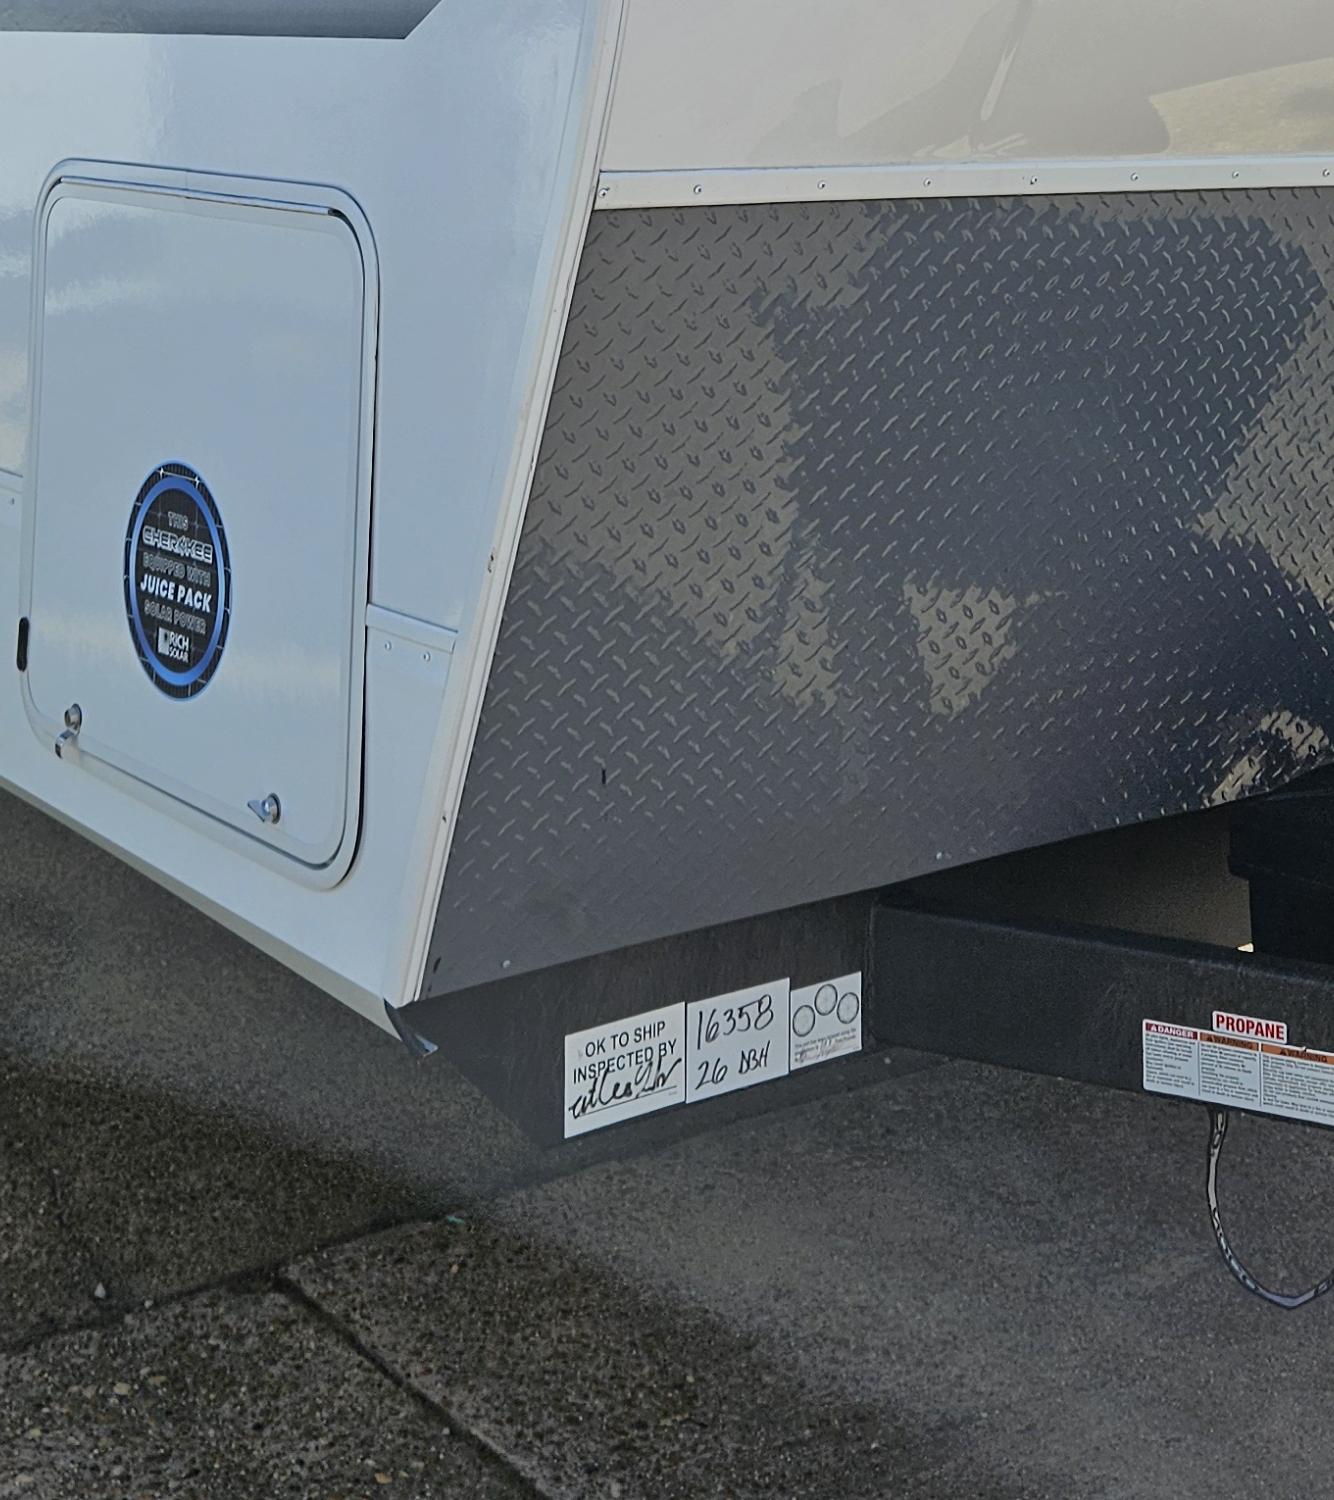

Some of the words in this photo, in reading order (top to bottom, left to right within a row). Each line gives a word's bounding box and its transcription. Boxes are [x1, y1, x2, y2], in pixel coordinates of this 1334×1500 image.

[167, 511, 189, 531] THIS
[142, 551, 186, 579] EQUIPPED
[186, 563, 211, 588] WITH
[140, 573, 175, 601] JUICE
[177, 584, 213, 613] PACK
[144, 599, 173, 624] SOLAR
[174, 610, 207, 635] POWER
[168, 646, 189, 664] SOLAR
[169, 631, 190, 649] RICH
[584, 1037, 606, 1058] OK
[610, 1031, 630, 1050] TO
[633, 1020, 666, 1044] SHIP
[697, 993, 774, 1051] 16358
[1157, 1025, 1194, 1039] DANGER
[1215, 1013, 1285, 1041] PROPANE
[573, 1046, 654, 1085] INSPECTED
[658, 1038, 677, 1058] BY
[694, 1056, 728, 1091] 26
